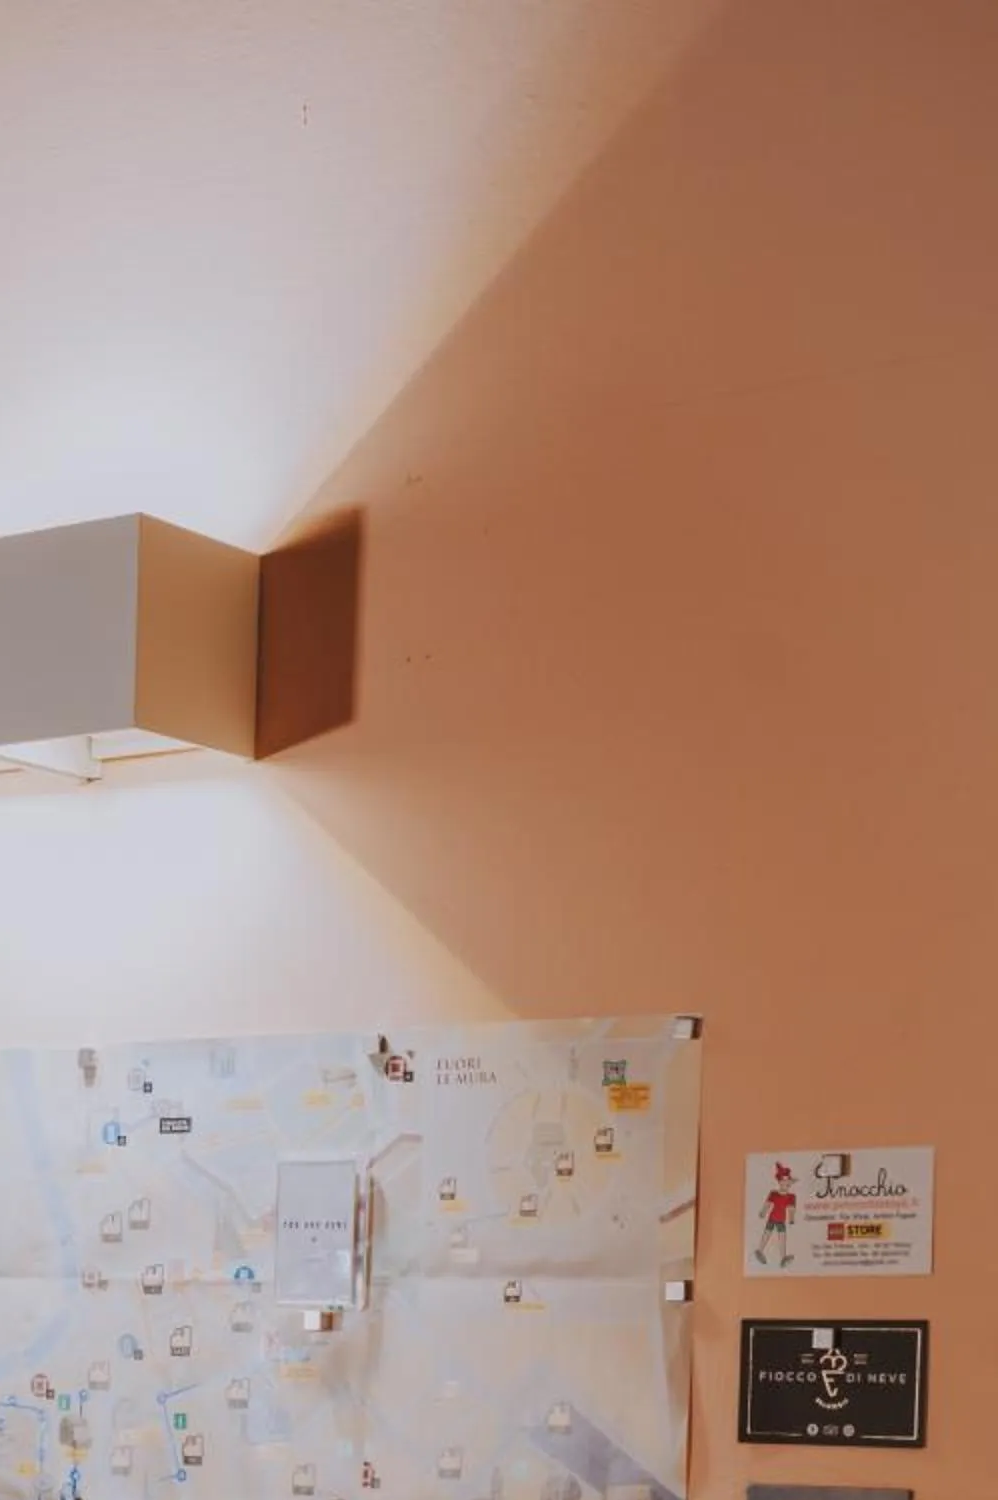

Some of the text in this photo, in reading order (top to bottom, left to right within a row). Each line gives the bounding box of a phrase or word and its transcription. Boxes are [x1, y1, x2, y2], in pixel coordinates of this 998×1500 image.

[436, 1057, 482, 1070] FUORI
[847, 1224, 883, 1236] STORE
[759, 1370, 907, 1385] FIOCCO DI NEVE
